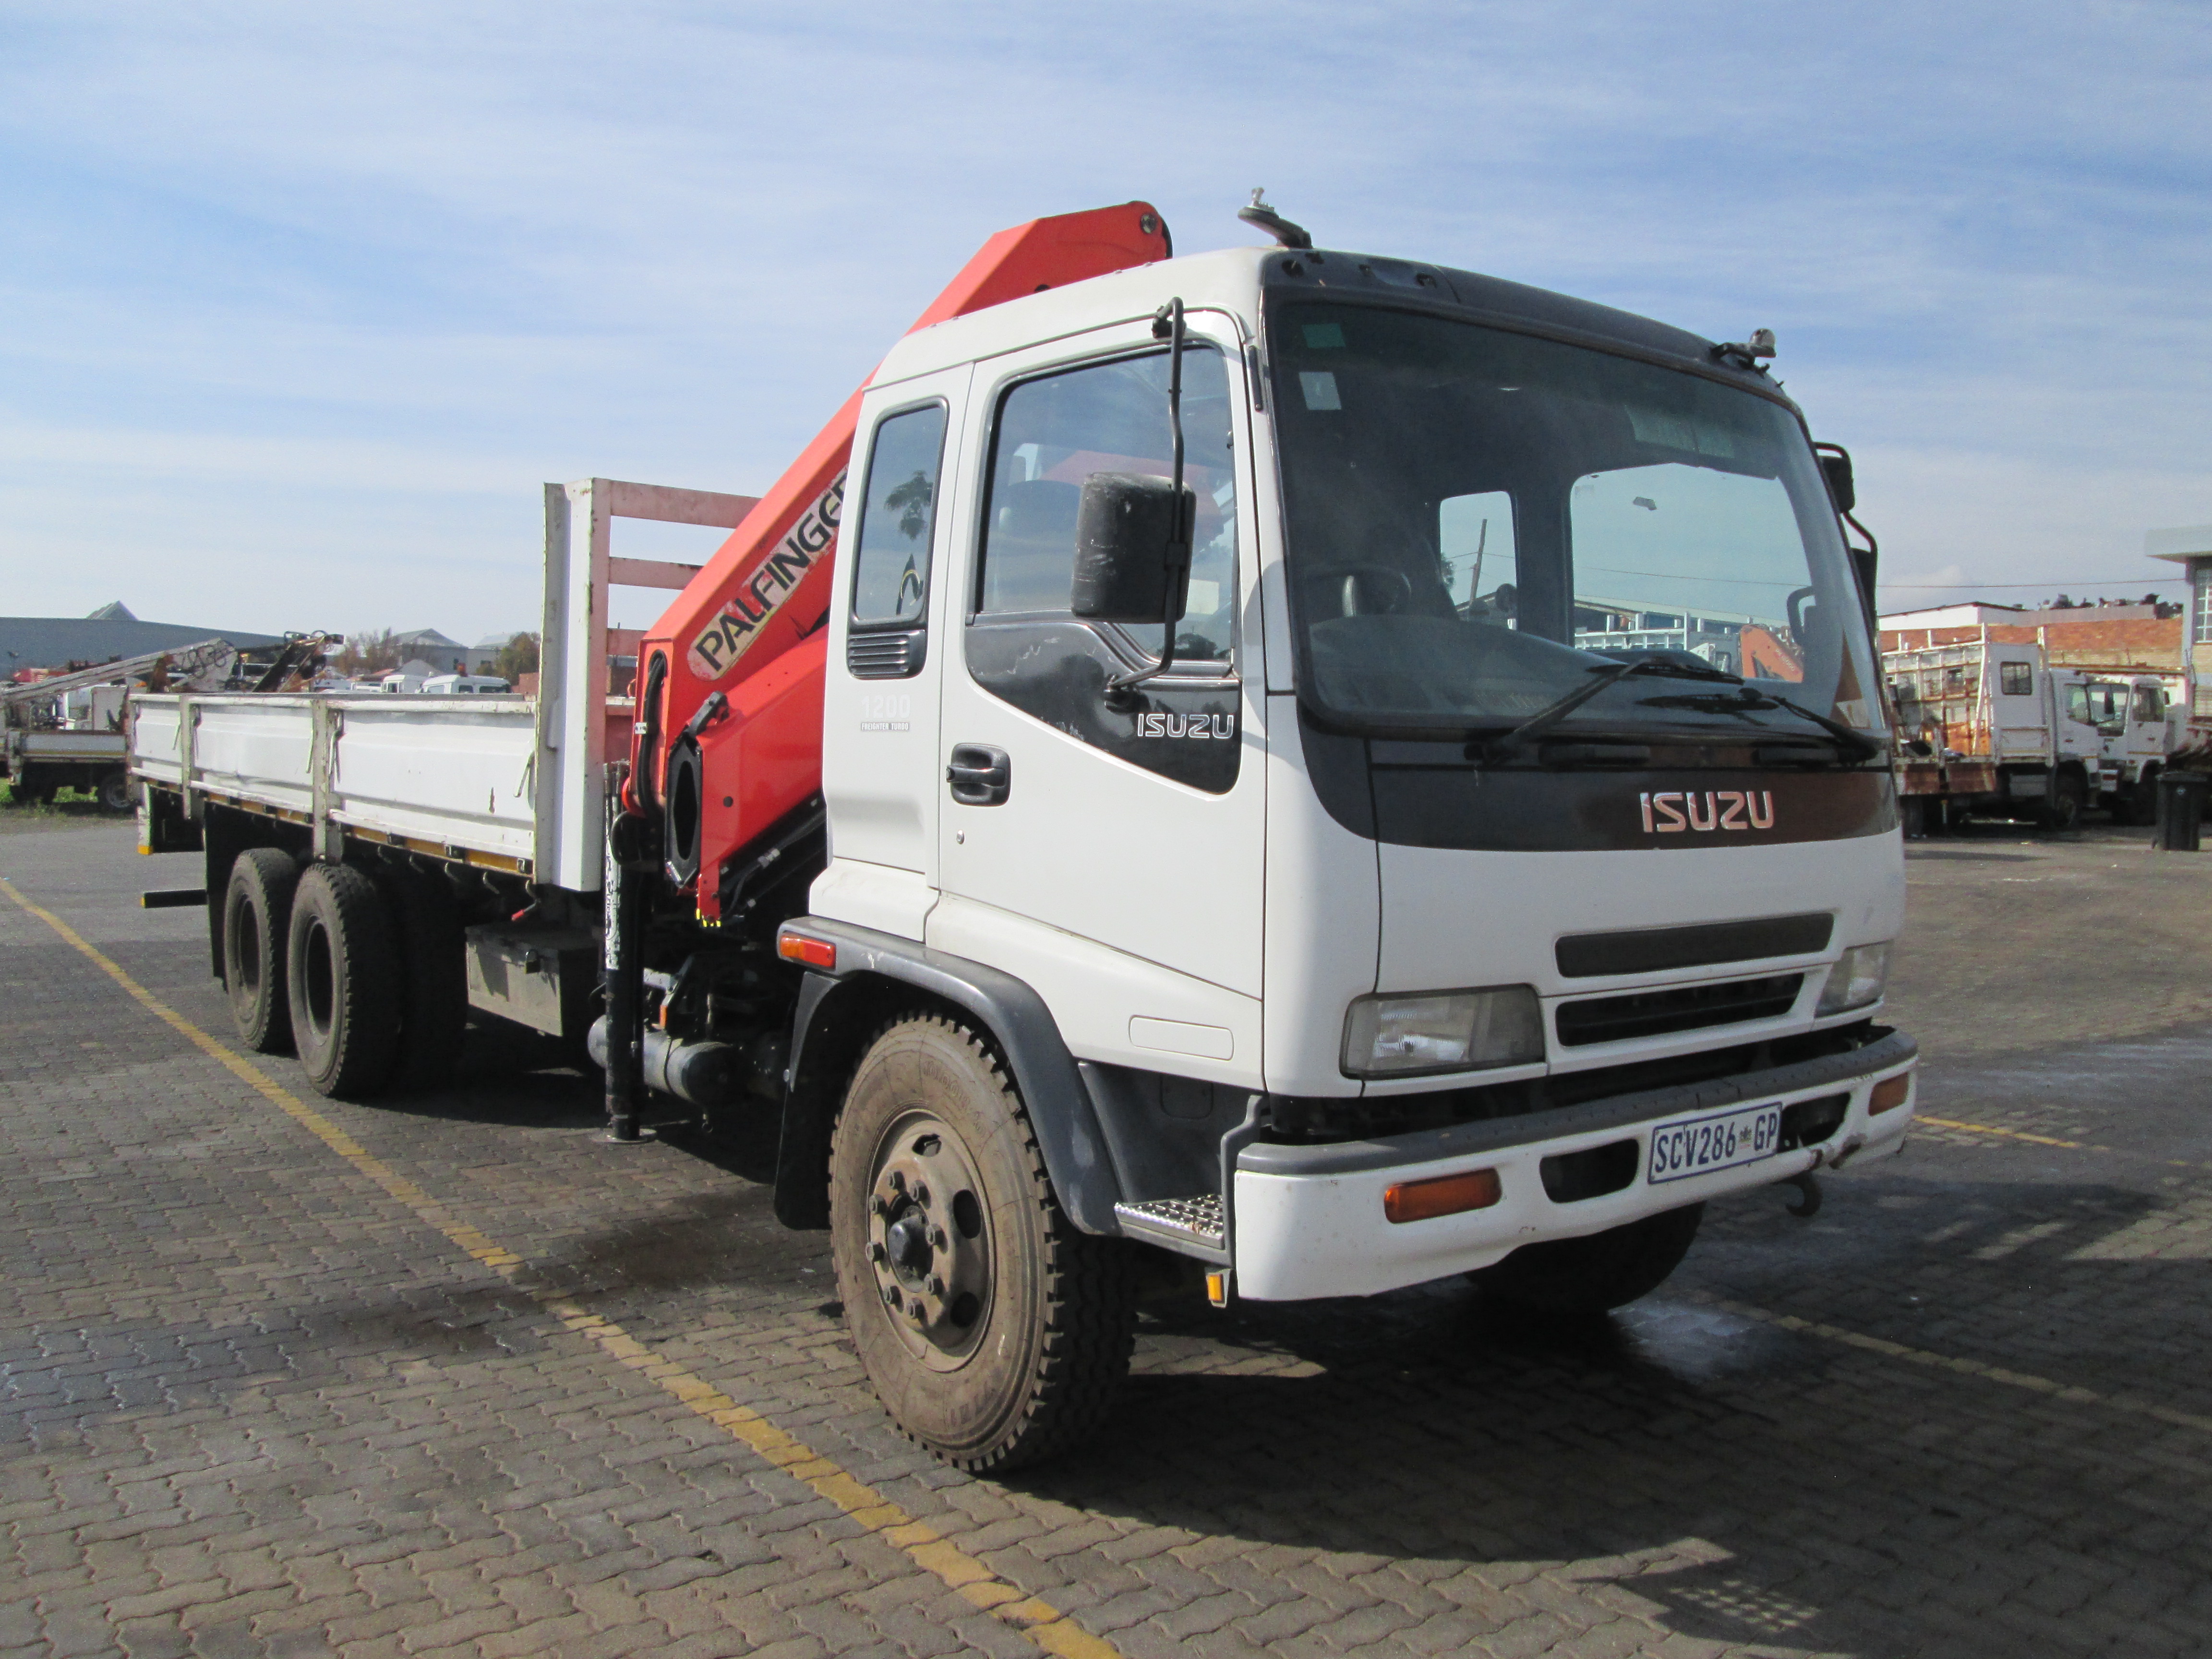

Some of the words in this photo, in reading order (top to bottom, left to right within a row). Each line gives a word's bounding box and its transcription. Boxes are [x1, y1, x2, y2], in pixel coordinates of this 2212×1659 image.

[862, 694, 911, 718] 1200
[1138, 713, 1234, 739] ISUZU
[1640, 791, 1775, 832] ISUZU
[1655, 1122, 1735, 1173] SCV286
[1755, 1113, 1778, 1150] GP
